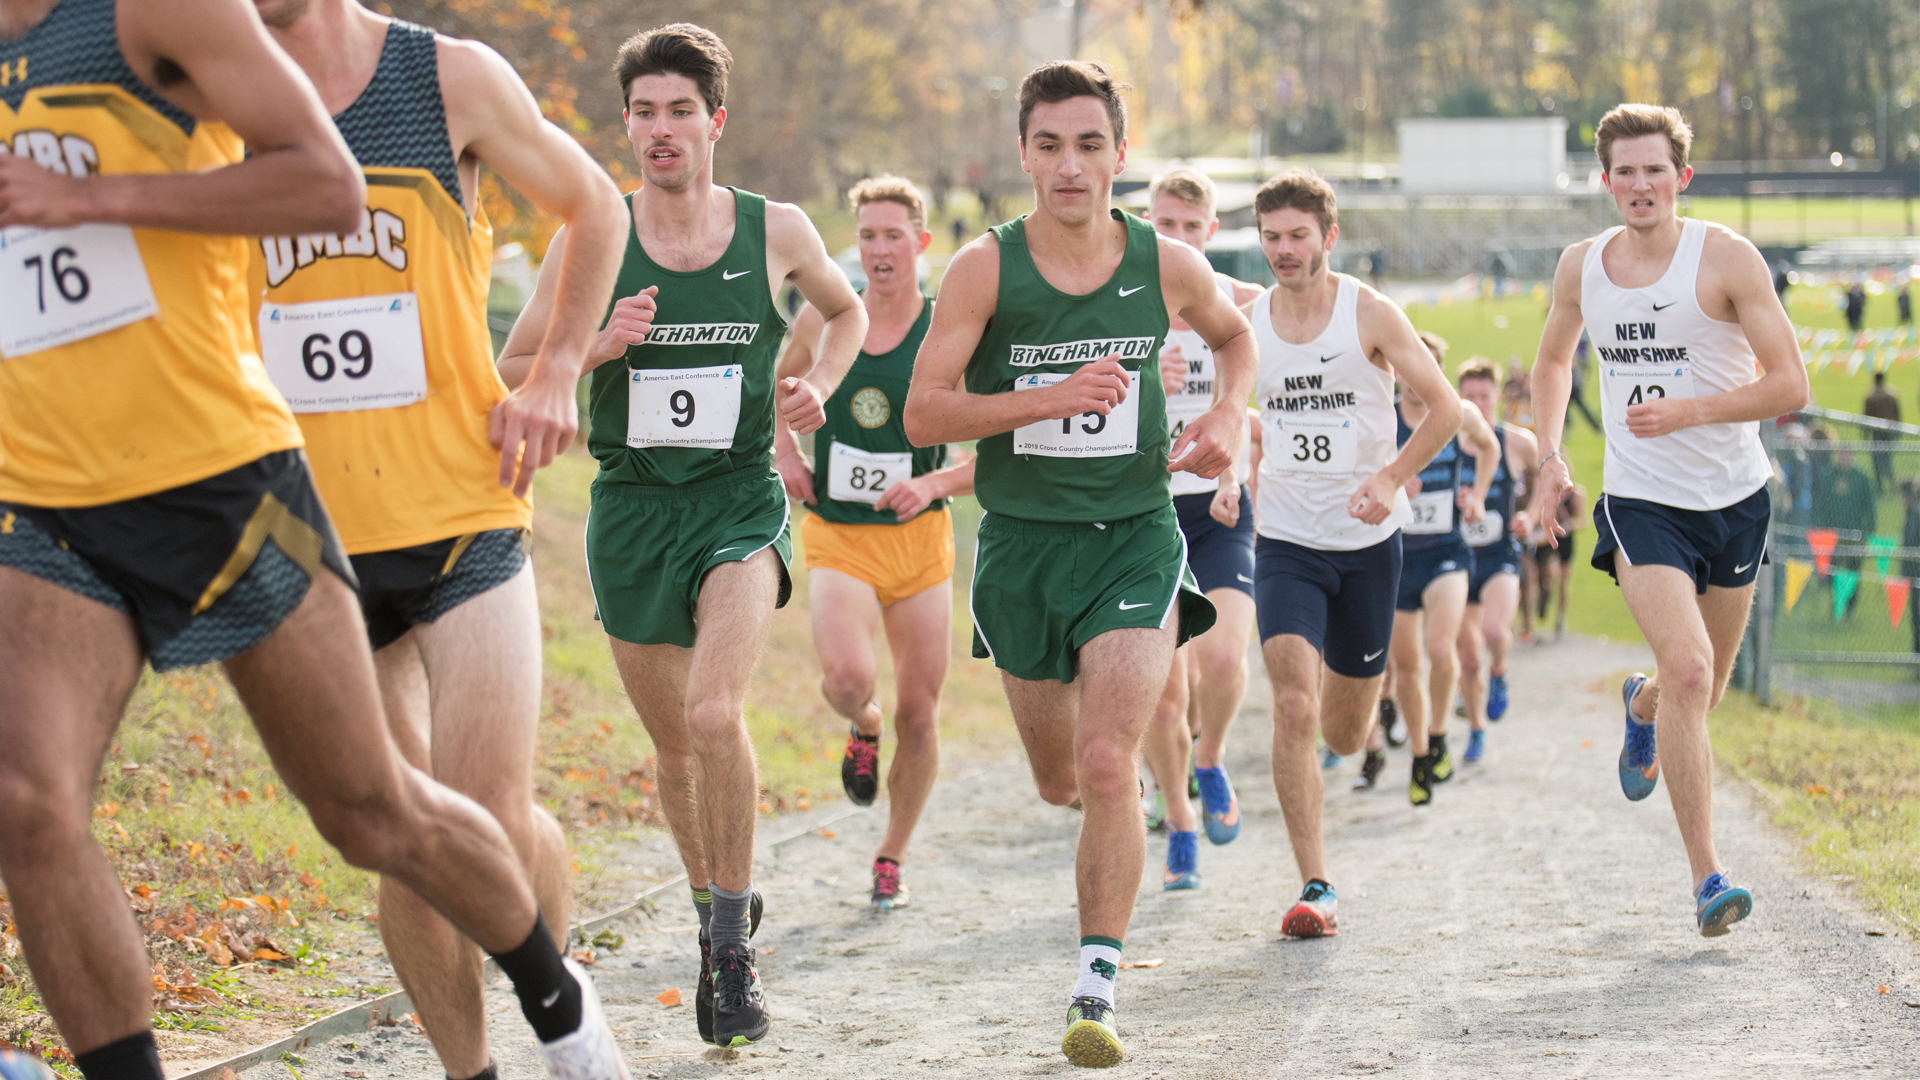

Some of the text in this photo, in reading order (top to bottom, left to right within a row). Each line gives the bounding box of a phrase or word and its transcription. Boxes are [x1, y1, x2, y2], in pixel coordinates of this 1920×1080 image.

[24, 246, 90, 314] 76
[644, 326, 757, 342] GHAMTON
[1615, 323, 1656, 341] NEW
[302, 329, 373, 383] 69
[1012, 339, 1153, 364] BINGHAMTON
[1598, 347, 1689, 363] HAMPSHIRE
[1284, 375, 1323, 392] NEW
[670, 389, 696, 428] 9
[1267, 392, 1356, 412] HAMPSHIRE
[1085, 444, 1128, 452] Championships
[1293, 434, 1332, 462] 38
[850, 466, 887, 491] 82
